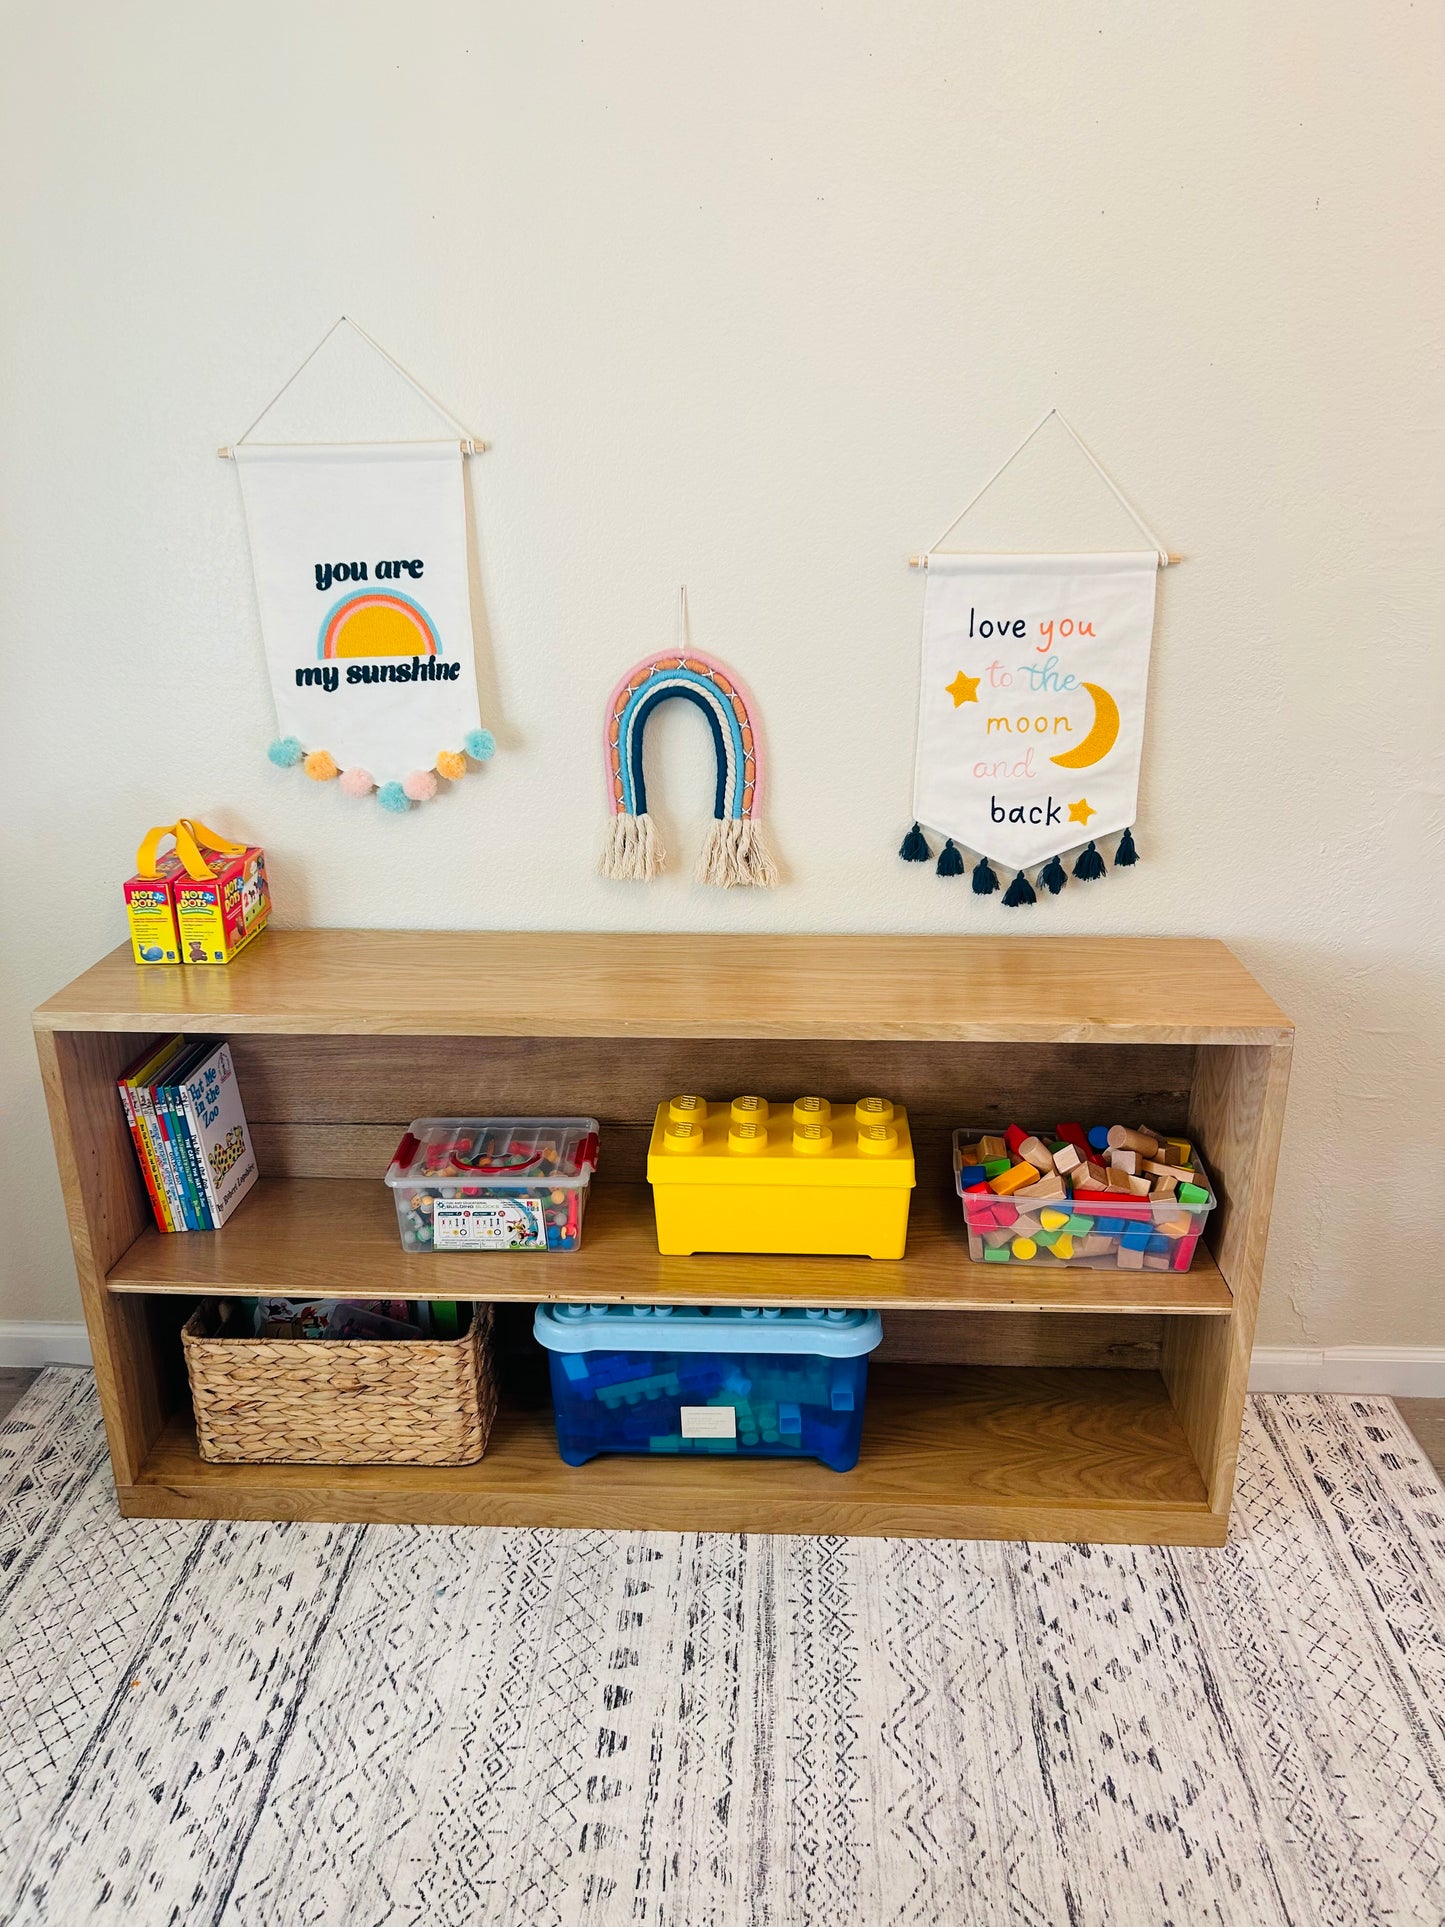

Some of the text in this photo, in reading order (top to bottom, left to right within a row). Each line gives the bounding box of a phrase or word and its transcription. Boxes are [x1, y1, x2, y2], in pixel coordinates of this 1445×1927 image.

[315, 559, 424, 591] you are
[969, 607, 1096, 653] love you
[295, 655, 461, 692] my sunshine
[985, 656, 1081, 692] to the
[987, 716, 1072, 735] moon
[973, 747, 1036, 778] and
[990, 795, 1061, 826] back
[130, 899, 157, 908] DOTS
[131, 890, 153, 900] HOT
[180, 899, 207, 908] DOTS
[181, 890, 203, 900] HOT
[189, 1066, 217, 1102] Put Me
[195, 1084, 220, 1118] in the
[203, 1105, 219, 1129] Zoo
[183, 1138, 191, 1148] THE
[186, 1148, 194, 1160] CAT
[194, 1177, 202, 1189] HAT
